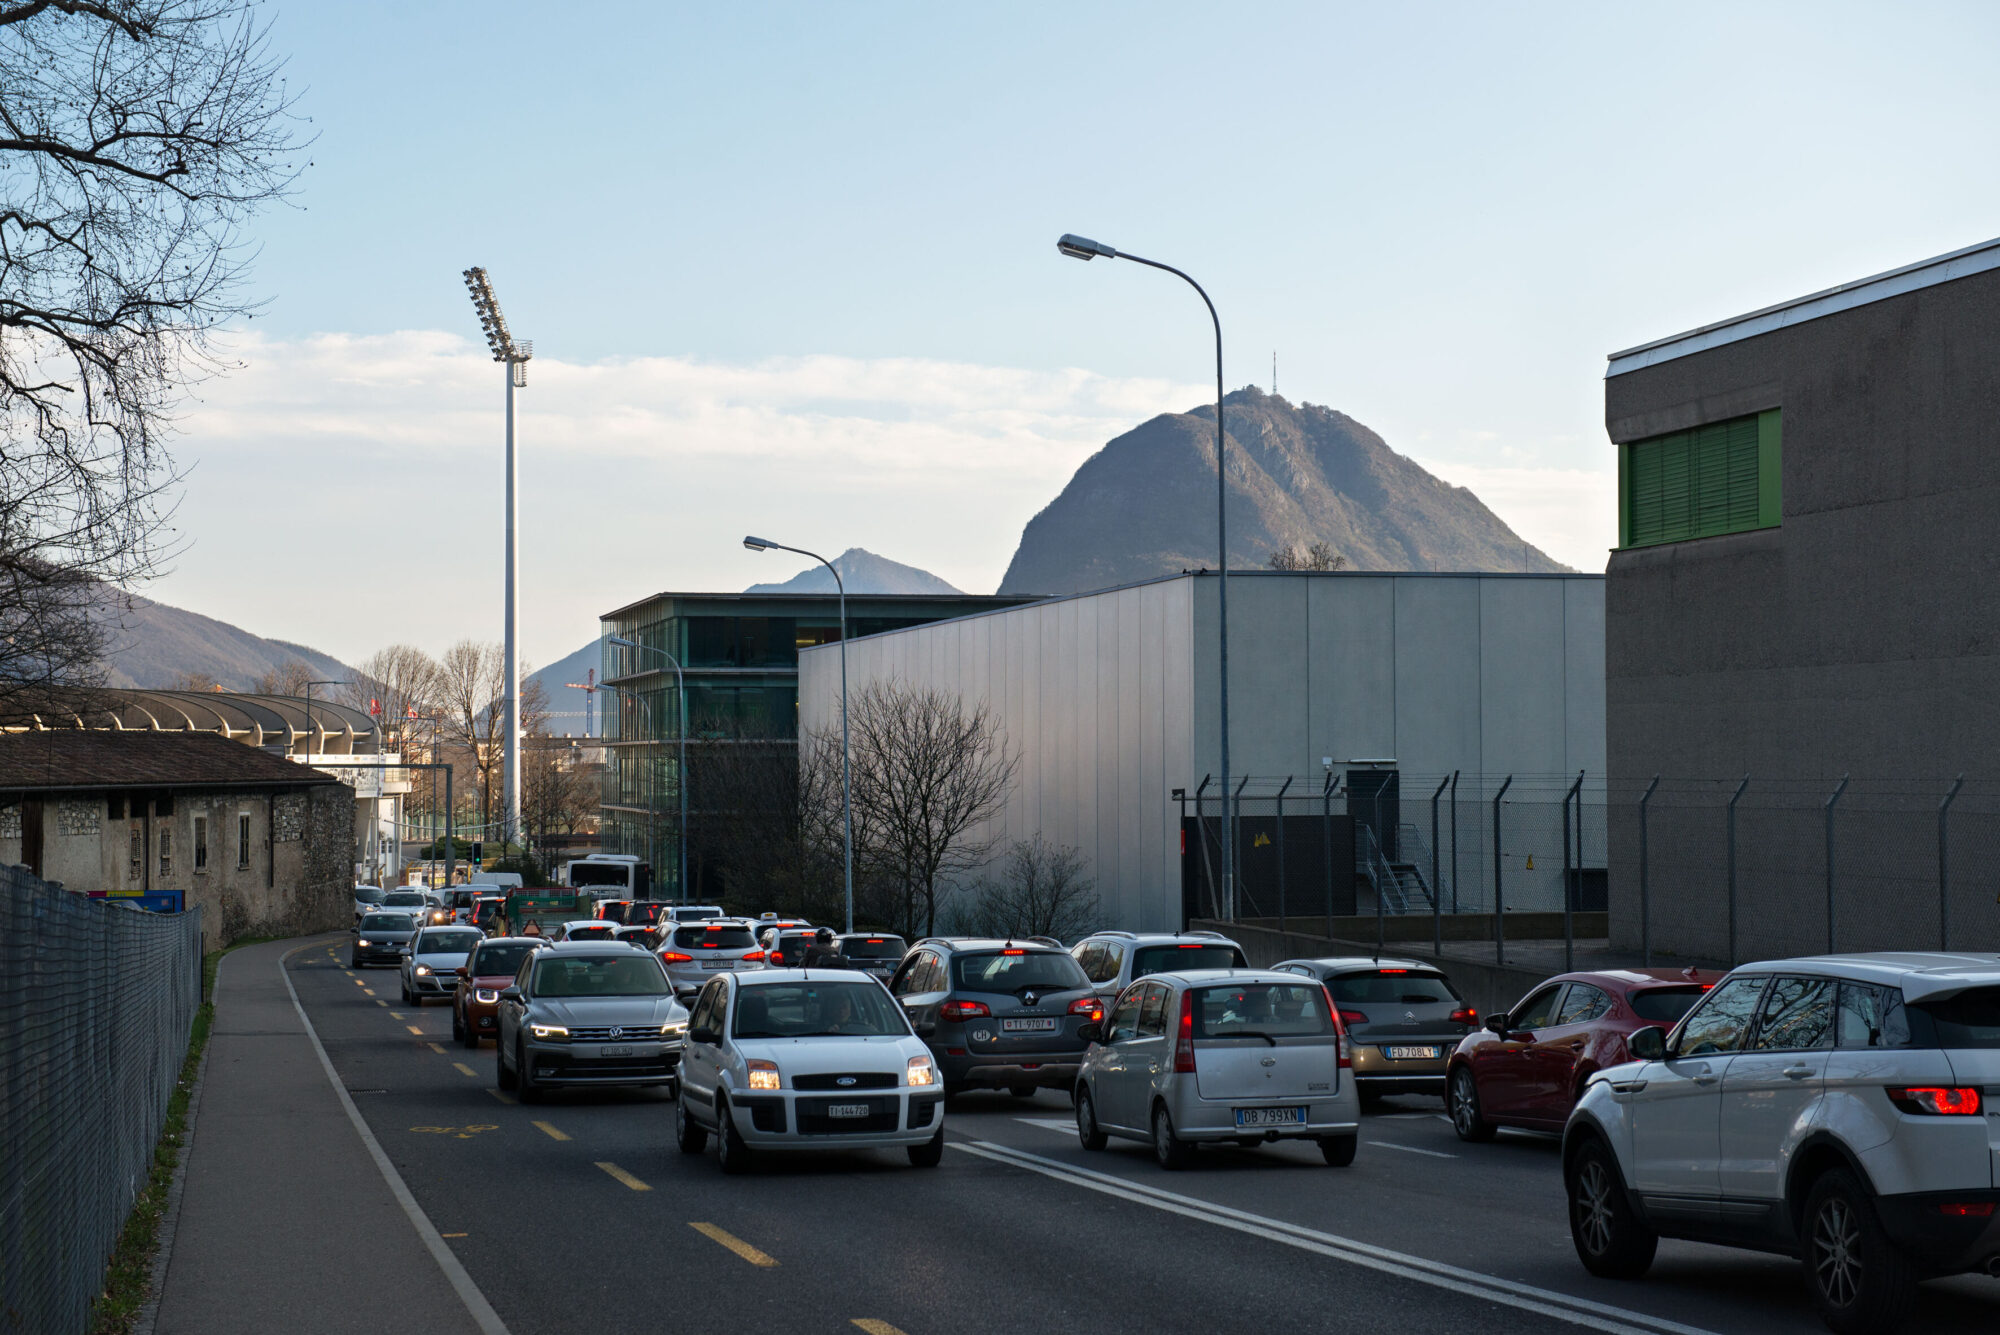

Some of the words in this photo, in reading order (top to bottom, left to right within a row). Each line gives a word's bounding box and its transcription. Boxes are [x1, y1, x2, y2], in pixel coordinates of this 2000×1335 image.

[976, 1031, 987, 1040] CH
[1391, 1048, 1403, 1057] FD
[1405, 1047, 1433, 1057] 708LY
[1244, 1111, 1258, 1123] DB
[1263, 1109, 1297, 1122] 799XN
